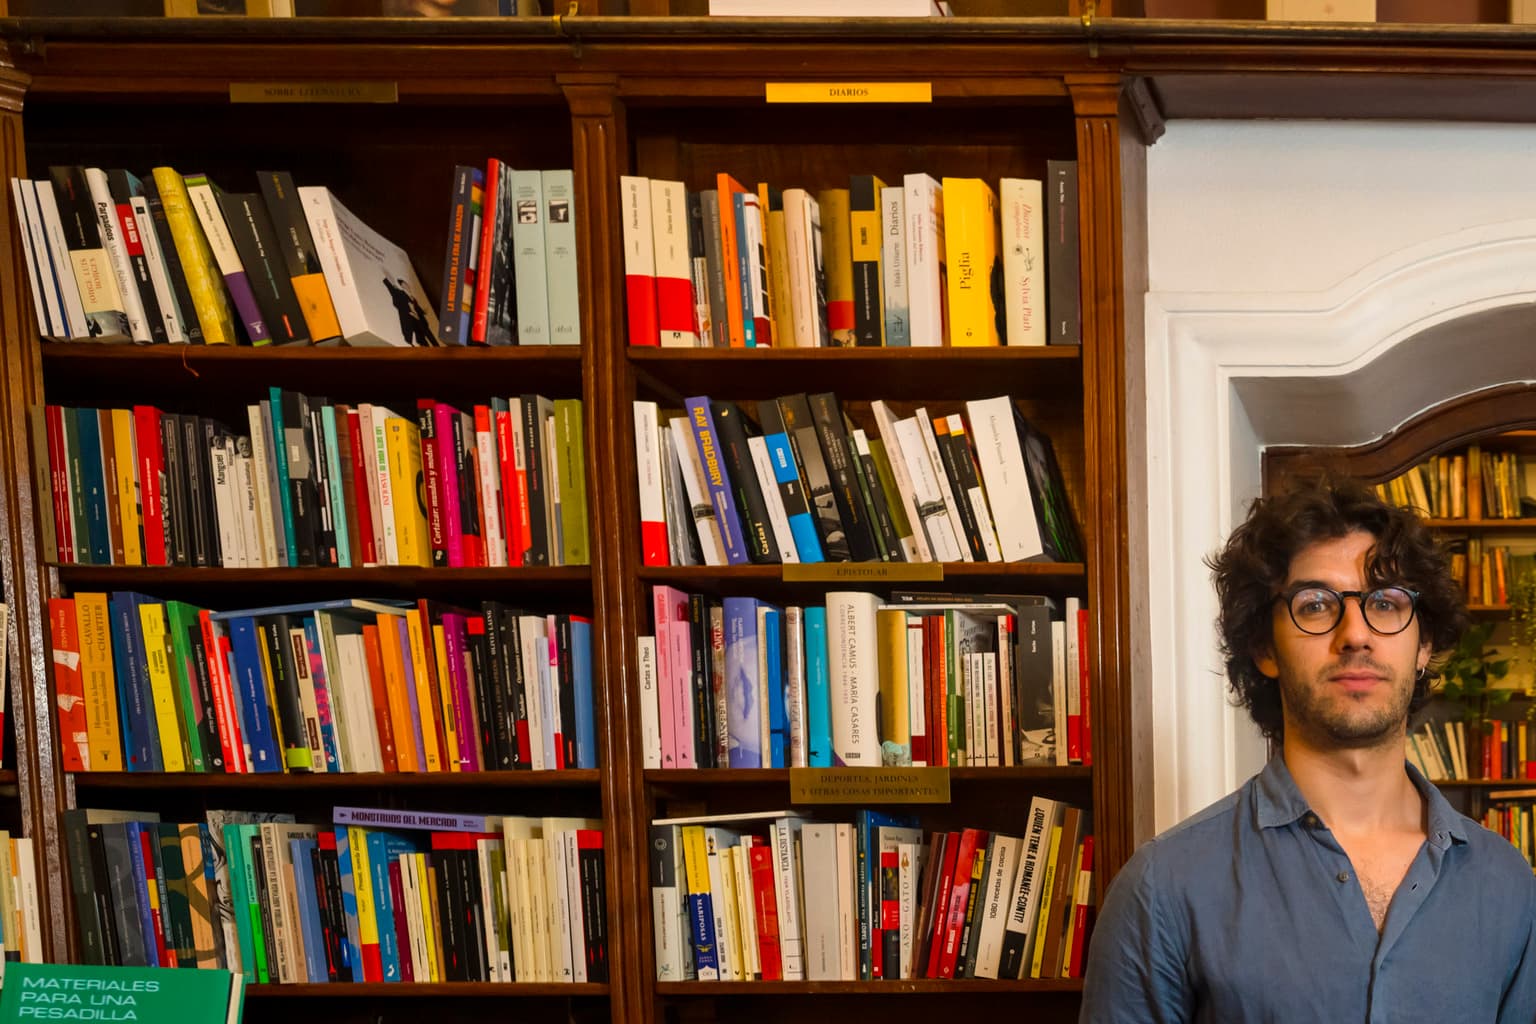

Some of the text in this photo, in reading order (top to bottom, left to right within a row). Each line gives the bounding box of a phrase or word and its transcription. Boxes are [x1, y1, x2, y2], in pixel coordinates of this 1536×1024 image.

[829, 87, 869, 97] DIARIOS
[97, 201, 115, 242] Parpadeos
[959, 250, 972, 291] Piglia
[425, 443, 435, 469] modos
[692, 407, 724, 488] RAY BRADBURY
[215, 454, 226, 485] Manguel
[847, 604, 860, 745] ALBERT CAMUS MARÍA CASARES
[350, 812, 458, 828] MONSTRUOS DEL MERCADO
[696, 898, 708, 942] MARIPOSAS
[22, 976, 160, 993] MATERIALES
[20, 992, 137, 1006] PARA UNA
[18, 1007, 138, 1021] PESADILLA
